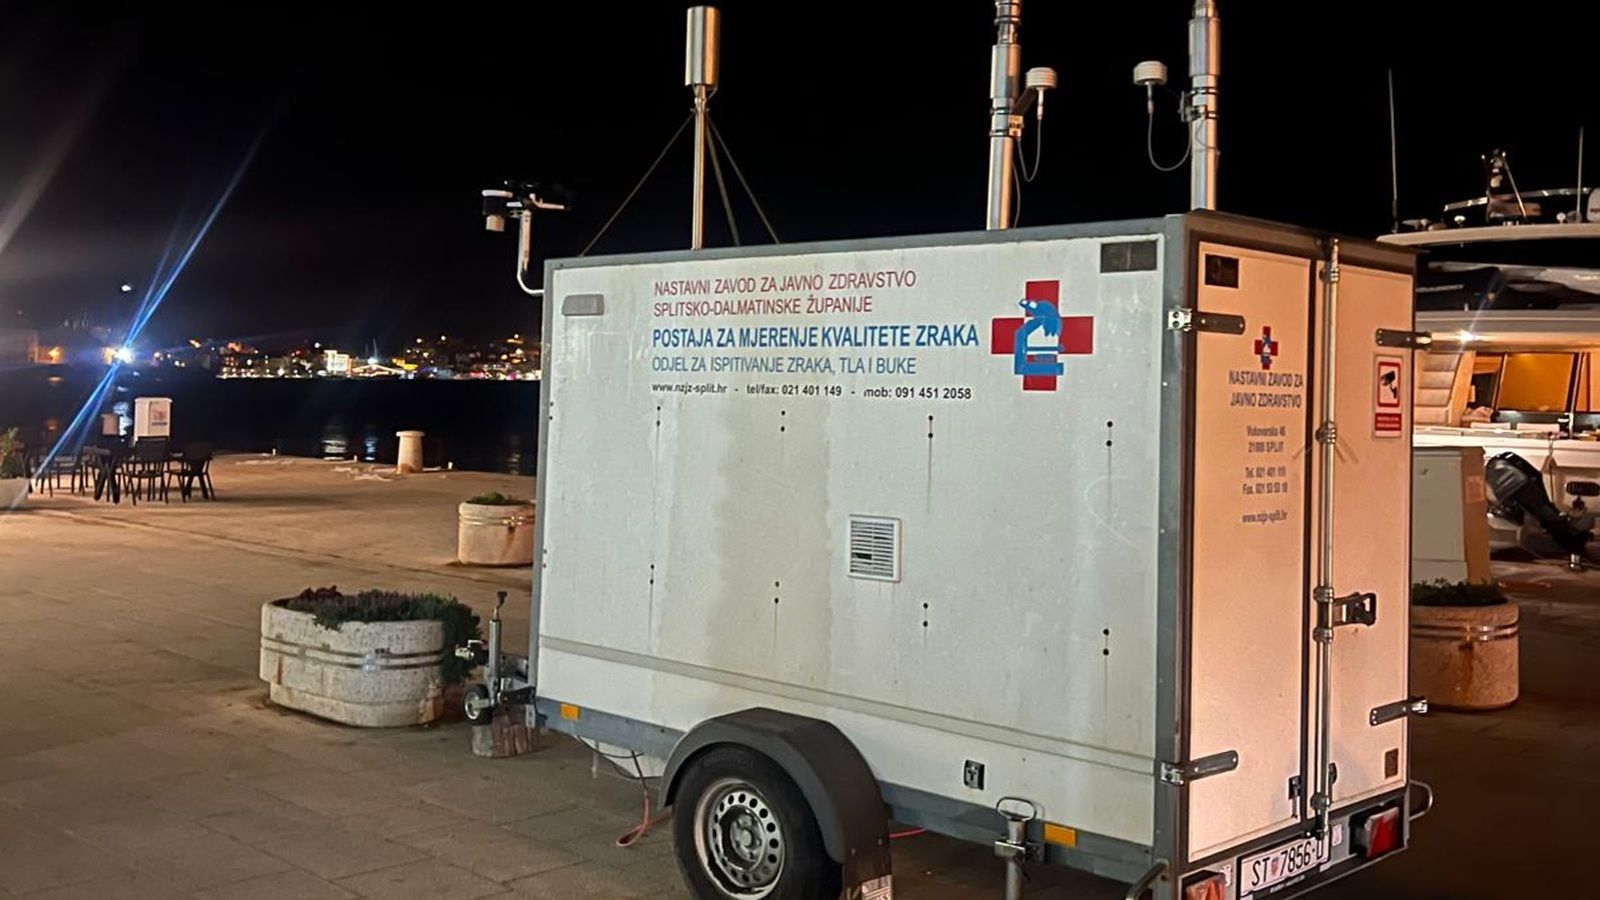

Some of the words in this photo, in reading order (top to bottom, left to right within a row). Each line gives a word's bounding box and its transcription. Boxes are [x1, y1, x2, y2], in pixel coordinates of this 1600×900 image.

[654, 280, 710, 296] NASTAVNI
[714, 278, 756, 294] ZAVOD
[760, 277, 777, 292] ZA
[780, 274, 823, 292] JAVNO
[829, 270, 917, 290] ZDRAVSTVO
[653, 298, 801, 317] SPLITSKO-DALMATINSKE
[807, 294, 873, 314] ŽUPANIJE
[653, 328, 714, 347] POSTAJA
[716, 328, 735, 347] ZA
[739, 326, 818, 348] MJERENJE
[821, 325, 911, 347] KVALITETE
[915, 324, 979, 346] ZRAKA
[652, 356, 689, 372] ODJEL
[691, 357, 706, 372] ZA
[710, 357, 784, 373] ISPITIVANJE
[787, 357, 836, 375] ZRAKA,
[840, 357, 865, 374] TLA
[868, 357, 872, 374] I
[876, 357, 917, 374] BUKE
[1228, 370, 1267, 386] NASTAVNI
[1268, 372, 1293, 387] ZAVOD
[1294, 373, 1304, 388] ZA
[651, 382, 727, 395] www.nzjz-split.hr
[746, 384, 779, 395] tel/fax:
[781, 385, 800, 395] 021
[802, 385, 820, 396] 401
[824, 385, 842, 397] 149
[864, 387, 892, 398] mob:
[895, 387, 914, 398] 091
[918, 387, 939, 399] 451
[943, 388, 972, 400] 2058
[1230, 392, 1256, 407] JAVNO
[1258, 393, 1302, 408] ZDRAVSTVO
[1266, 441, 1284, 453] SPLIT
[1251, 857, 1270, 886] ST
